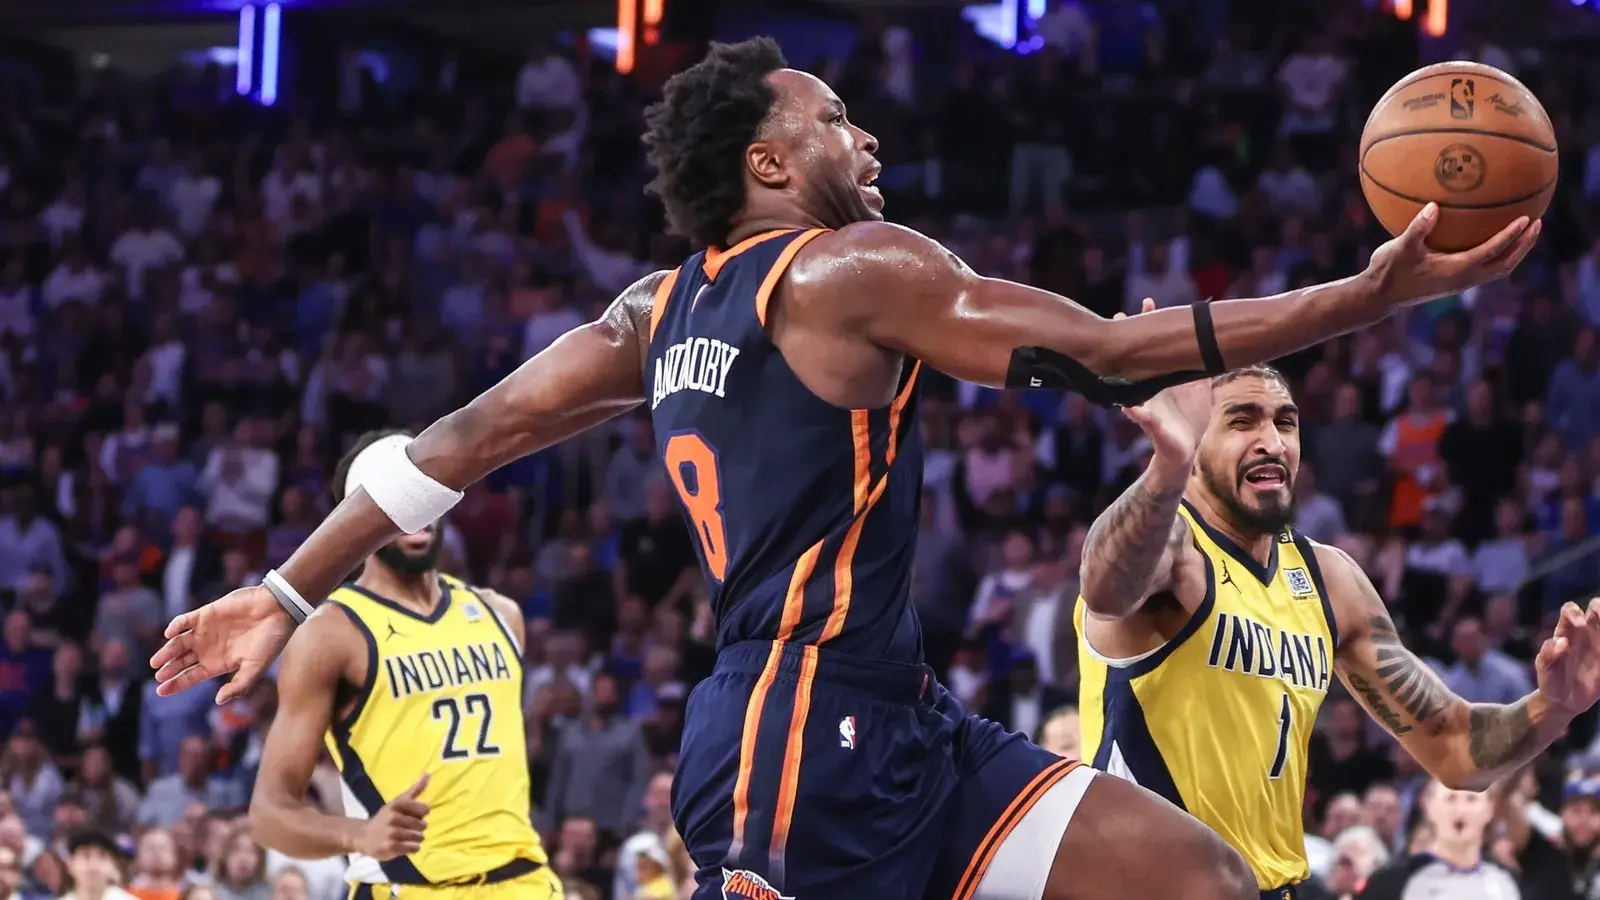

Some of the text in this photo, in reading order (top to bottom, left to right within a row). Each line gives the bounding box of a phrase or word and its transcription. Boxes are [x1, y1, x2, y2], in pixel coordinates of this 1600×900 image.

[664, 433, 728, 584] 8
[385, 642, 511, 699] INDIANA
[431, 694, 501, 760] 22
[1269, 693, 1292, 778] 1
